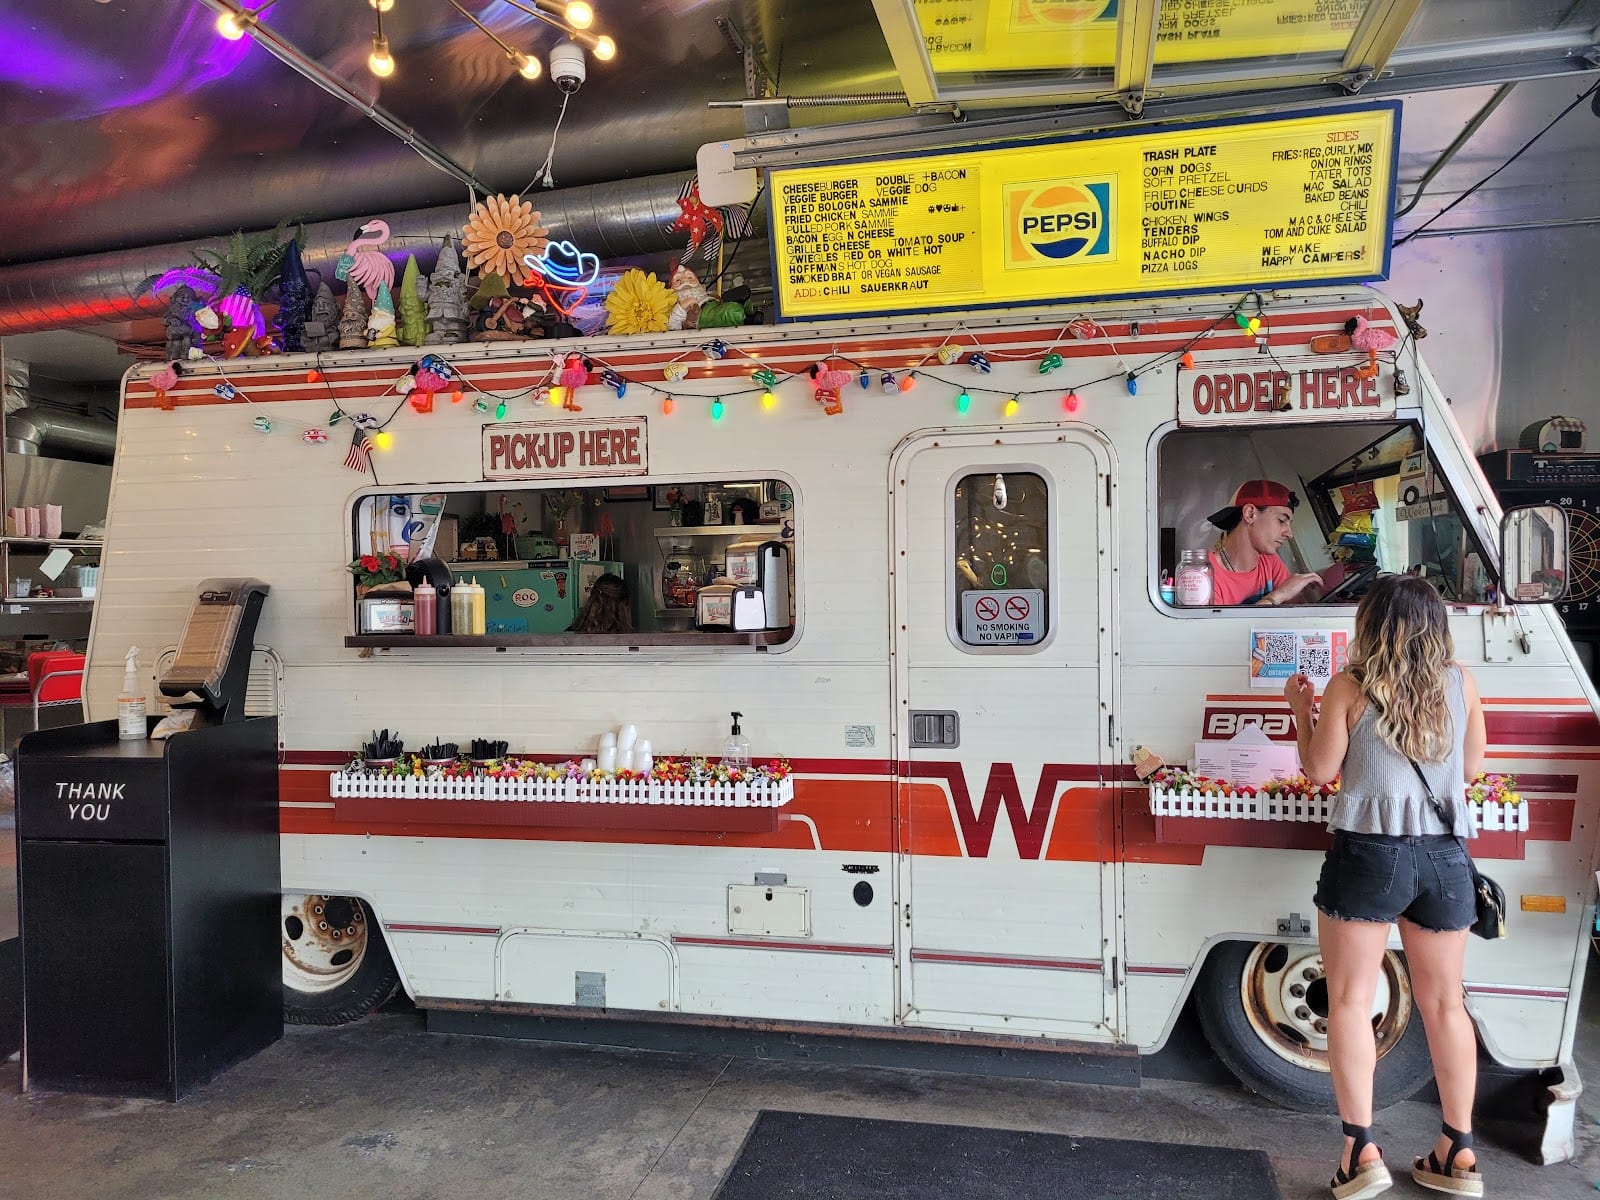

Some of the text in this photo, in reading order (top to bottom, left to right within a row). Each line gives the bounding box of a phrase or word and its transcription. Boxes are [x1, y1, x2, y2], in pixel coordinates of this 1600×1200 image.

[1326, 130, 1360, 143] SIDES
[1143, 145, 1217, 161] TRASH PLATE
[1357, 142, 1374, 153] MIX
[1143, 162, 1212, 177] CORN DOGS
[1310, 154, 1373, 170] ONION RINGS
[876, 169, 966, 186] DOUBLE +BACON
[1143, 172, 1231, 189] SOFT PRETZEL
[1309, 166, 1372, 180] TATER TOTS
[783, 179, 858, 195] CHEESEBURGER
[876, 182, 937, 197] VEGGIE DOG
[1144, 181, 1268, 201] FRIED CHEESE CURDS
[1303, 177, 1372, 192] MAC SALAD
[783, 190, 858, 205] VEGGIE BURGER
[1304, 188, 1369, 204] BAKED BEANS
[784, 196, 909, 215] FRIED BOLOGNA SAMMIE
[1145, 199, 1196, 212] POUTINE
[1340, 199, 1368, 211] CHILI
[785, 207, 899, 225] FRIED CHICKEN SAMMIE
[1023, 211, 1097, 235] PEPSI
[1142, 211, 1230, 227] CHICKEN WINGS
[1289, 210, 1367, 227] MAC & CHEESE
[786, 218, 894, 235] PULLED PORK SAMMIE
[1143, 225, 1199, 238] TENDERS
[1264, 221, 1367, 239] TOM AND CUKE SALAD
[786, 228, 895, 245] BACON EGG N CHEESE
[892, 232, 965, 247] TOMATO SOUP
[1141, 235, 1200, 249] BUFFALO DIP
[786, 241, 870, 255] GRILLED CHEESE
[789, 245, 943, 264] ZWIEGLES RED OR WHITE HOT
[1143, 247, 1206, 261] NACHO DIP
[1262, 243, 1321, 256] WE MAKE
[847, 260, 867, 270] HOT
[871, 259, 893, 269] DOG
[1141, 260, 1199, 274] PIZZA LOGS
[1262, 255, 1295, 267] HAPPY
[790, 265, 941, 284] SMOKED BRAT OR VEGAN SAUSAGE
[794, 280, 929, 298] ADD: CHILI SAUERKRAUT
[1192, 366, 1381, 415] ORDER HERE
[489, 426, 641, 470] PICK-UP HERE
[1560, 497, 1573, 505] 20
[1562, 605, 1569, 613] 3
[1578, 603, 1589, 611] 17
[990, 623, 1030, 631] SMOKING
[979, 632, 1020, 640] NO VAPIN
[55, 781, 127, 800] THANK
[68, 803, 111, 821] YOU
[948, 762, 1058, 860] W
